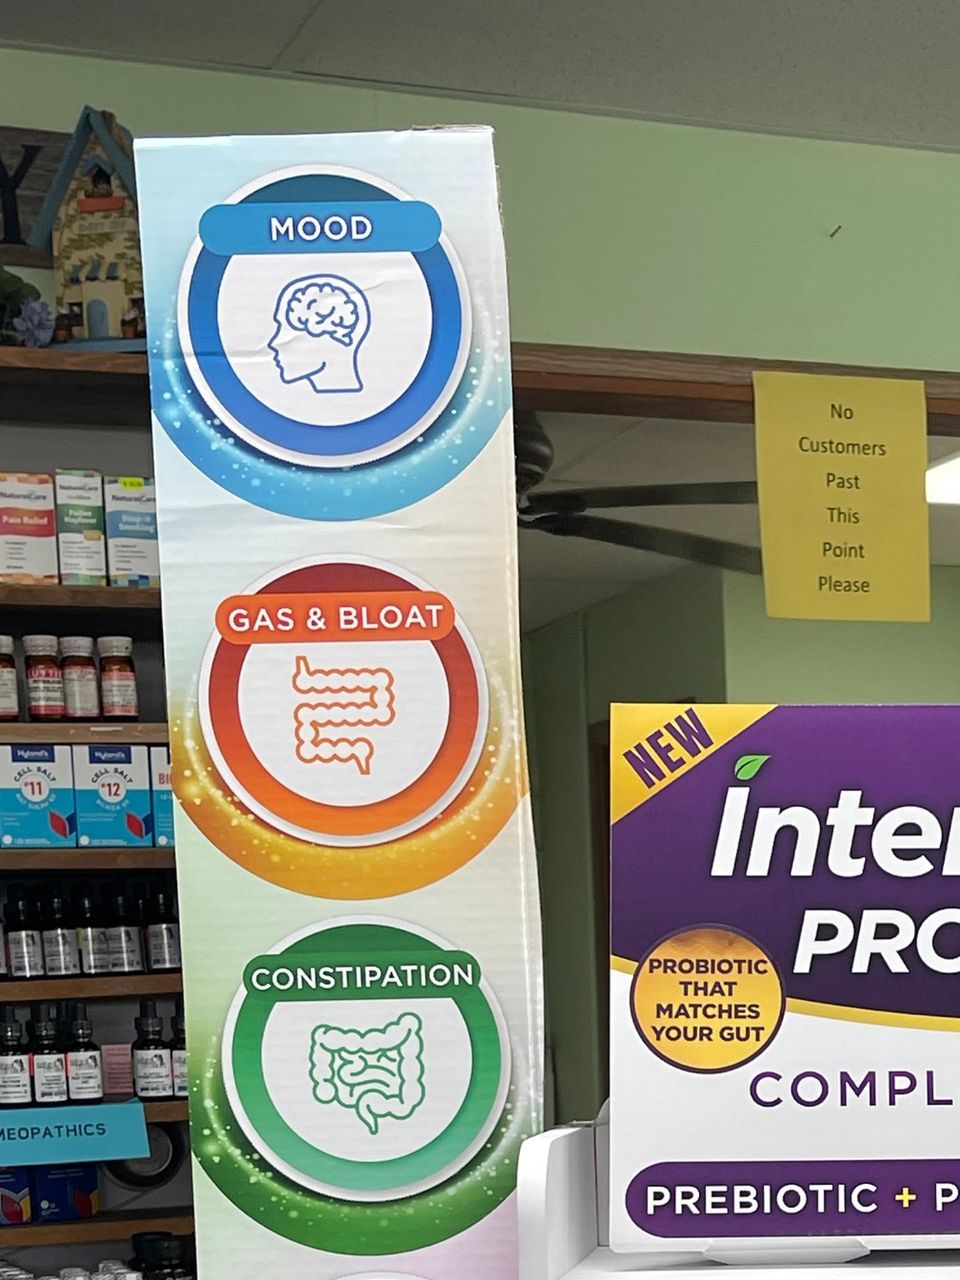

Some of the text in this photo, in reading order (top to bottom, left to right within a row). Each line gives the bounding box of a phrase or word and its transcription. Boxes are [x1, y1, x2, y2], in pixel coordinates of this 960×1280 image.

[270, 215, 373, 241] MOOD
[830, 403, 854, 420] No
[799, 436, 886, 456] Customers
[826, 473, 860, 489] Past
[827, 507, 860, 524] This
[822, 542, 865, 558] Point
[818, 576, 871, 593] Please
[228, 604, 444, 632] GAS & BLOAT
[17, 750, 49, 759] Hyland's
[94, 751, 126, 760] Hyland's
[622, 707, 714, 790] NEW
[14, 766, 57, 783] CELL SALT
[91, 767, 133, 784] CELL SALT
[648, 958, 768, 975] PROBIOTIC
[251, 963, 473, 991] CONSTIPATION
[679, 981, 737, 997] THAT
[655, 1003, 761, 1020] MATCHES
[651, 1026, 765, 1043] YOUR GUT
[646, 1183, 878, 1216] PREBIOTIC
